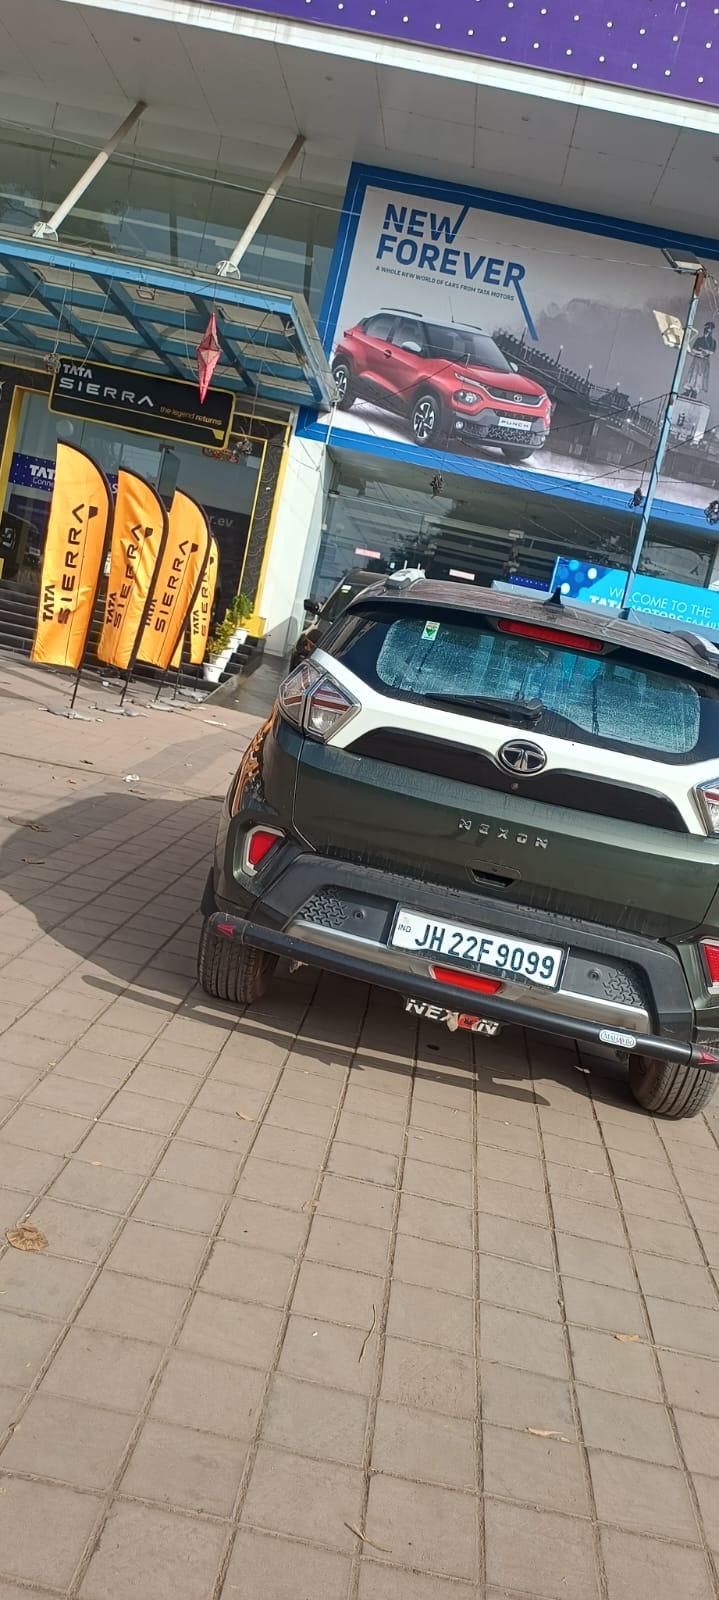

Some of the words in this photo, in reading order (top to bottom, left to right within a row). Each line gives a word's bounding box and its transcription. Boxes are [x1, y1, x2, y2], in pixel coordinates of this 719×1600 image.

[383, 203, 468, 244] NEW
[375, 233, 526, 288] FOREVER
[381, 267, 401, 277] WHOLE
[401, 271, 415, 279] NEW
[415, 274, 436, 284] WORLD
[436, 278, 444, 286] OF
[444, 280, 460, 290] CARS
[460, 283, 476, 293] FROM
[477, 287, 491, 296] TATA
[490, 291, 514, 301] MOTORS
[63, 363, 93, 379] TATA
[59, 377, 154, 407] SIERRA
[160, 406, 172, 414] the
[172, 408, 196, 420] legend
[195, 414, 223, 426] returns
[29, 464, 56, 480] TAT
[32, 476, 54, 487] Conn
[57, 503, 85, 625] SIERRA
[42, 584, 55, 622] TATA
[154, 540, 189, 633] SIERRA
[106, 592, 117, 625] TATA
[671, 599, 688, 613] TO
[690, 604, 713, 618] THE
[458, 818, 549, 849] NEXON
[398, 923, 412, 933] IND
[414, 924, 445, 953] JH
[495, 943, 555, 979] 9099
